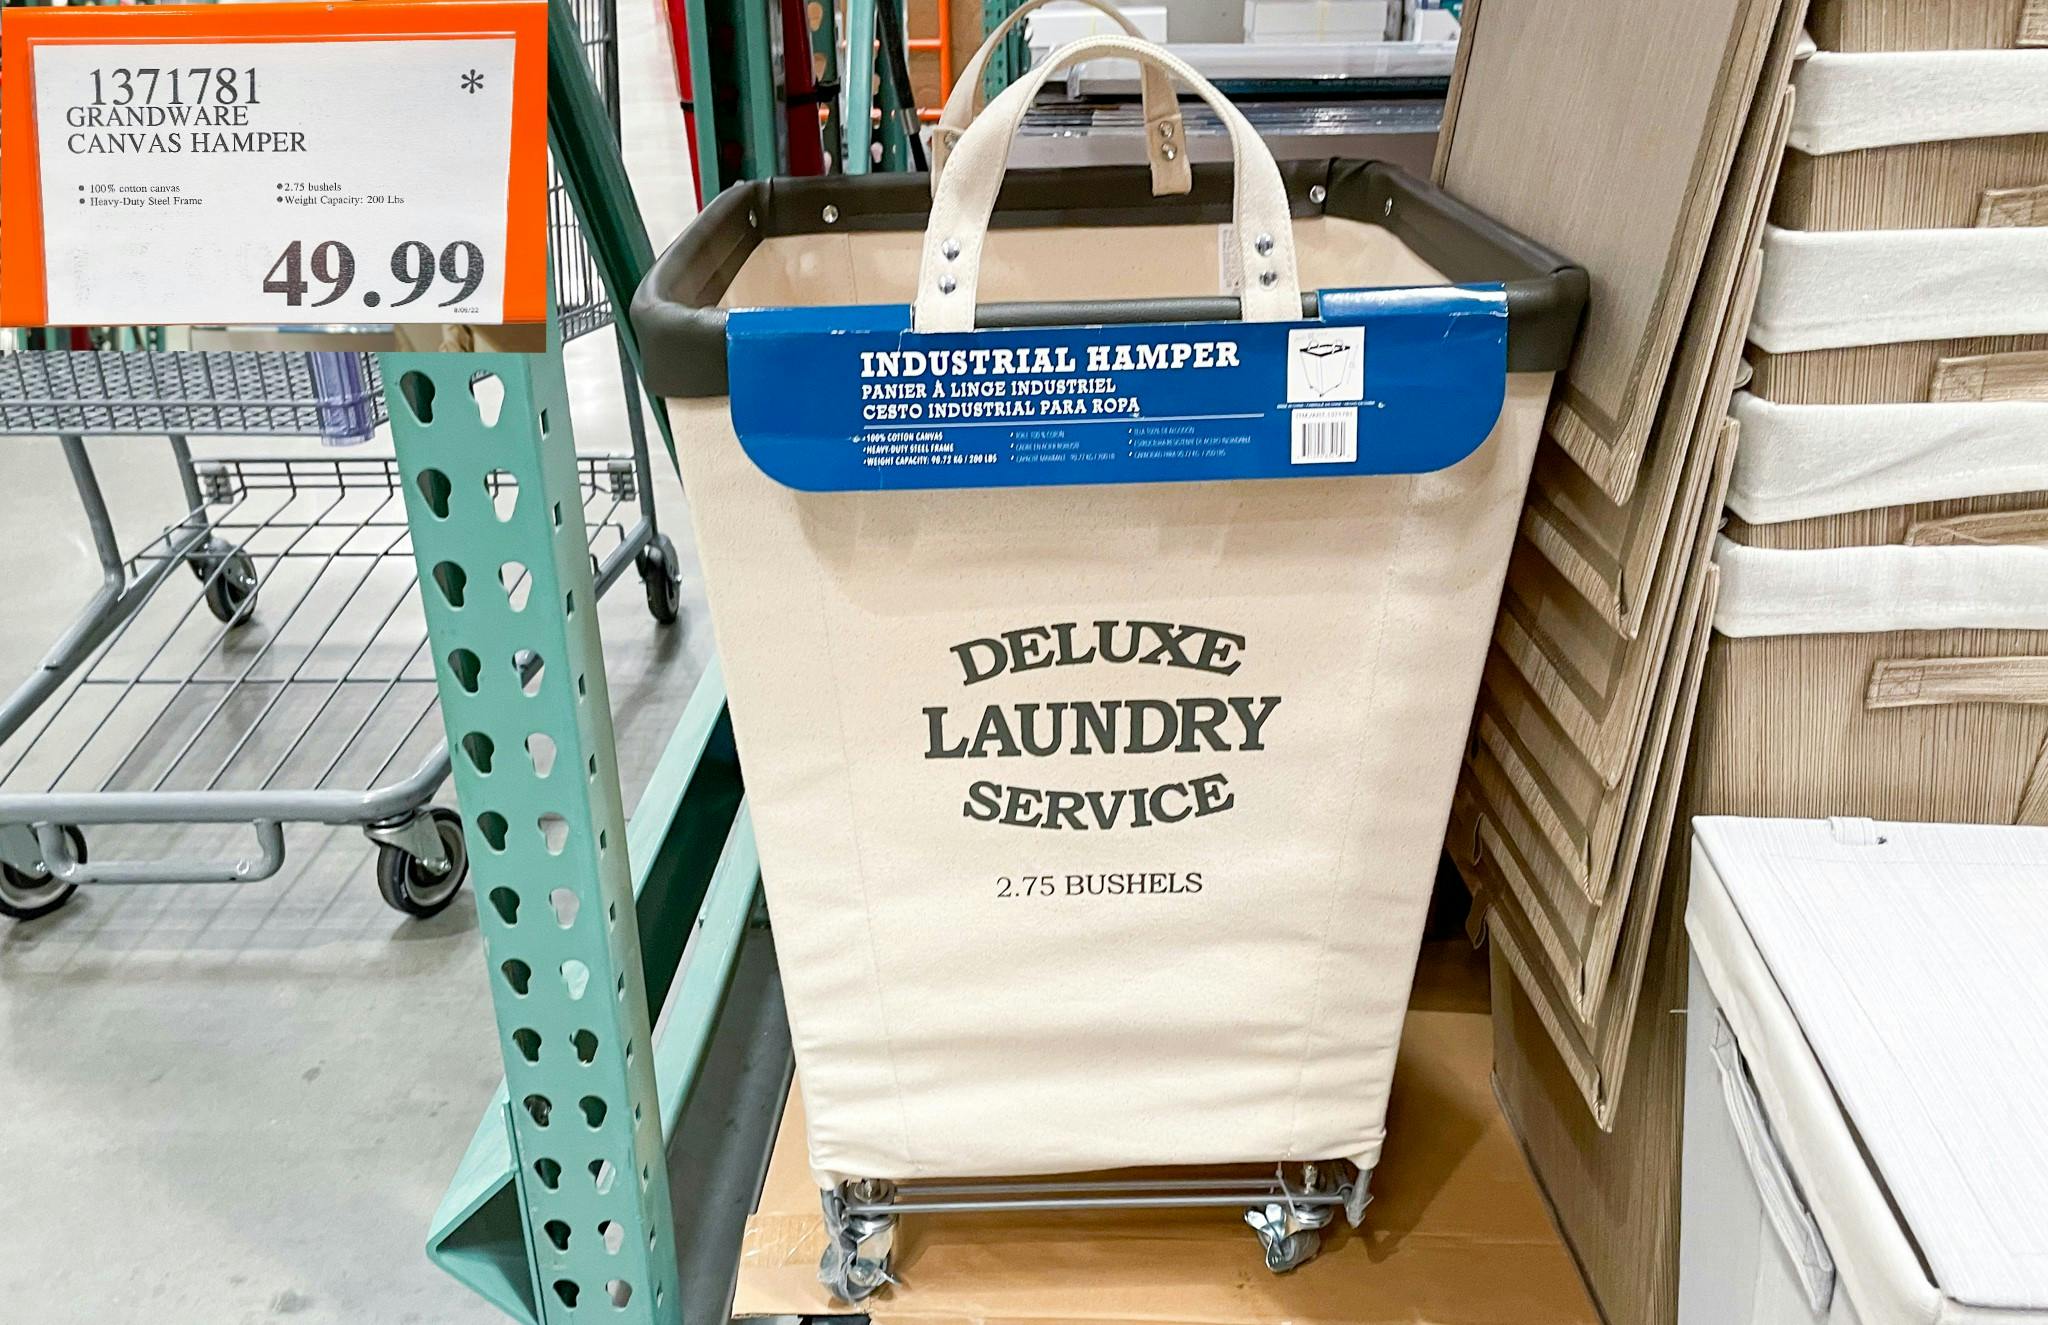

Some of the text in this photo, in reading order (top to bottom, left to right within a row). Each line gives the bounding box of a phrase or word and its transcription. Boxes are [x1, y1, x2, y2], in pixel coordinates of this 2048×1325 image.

[89, 67, 260, 105] 1371781
[66, 106, 249, 127] GRANDWARE
[67, 132, 307, 154] CANVAS HAMPER
[90, 184, 180, 193] 100% cotton canvas
[285, 182, 342, 191] 2.75 bushels
[90, 197, 203, 207] Heavy-Duty Steel Frame
[285, 195, 405, 206] Weight Capacity: 200 Lbs
[263, 240, 485, 308] 49.99
[860, 342, 1240, 377] INDUSTRIAL HAMPER
[861, 383, 927, 400] PANIER
[950, 381, 1006, 397] LINGE
[1010, 378, 1116, 396] INDUSTRIEL
[863, 397, 1141, 420] CESTO INDUSTRIAL PARA ROPA
[866, 431, 943, 443] 100% COTTON CANVAS
[910, 444, 929, 453] STEEL
[931, 443, 954, 452] FRAME
[866, 457, 893, 466] WEIGHT
[953, 454, 963, 464] KG
[969, 454, 982, 464] 200
[984, 453, 997, 463] LBS
[950, 621, 1246, 685] DELUXE
[922, 696, 1282, 759] LAUNDRY
[963, 773, 1235, 830] SERVICE
[996, 872, 1203, 898] 2.75 BUSHELS
